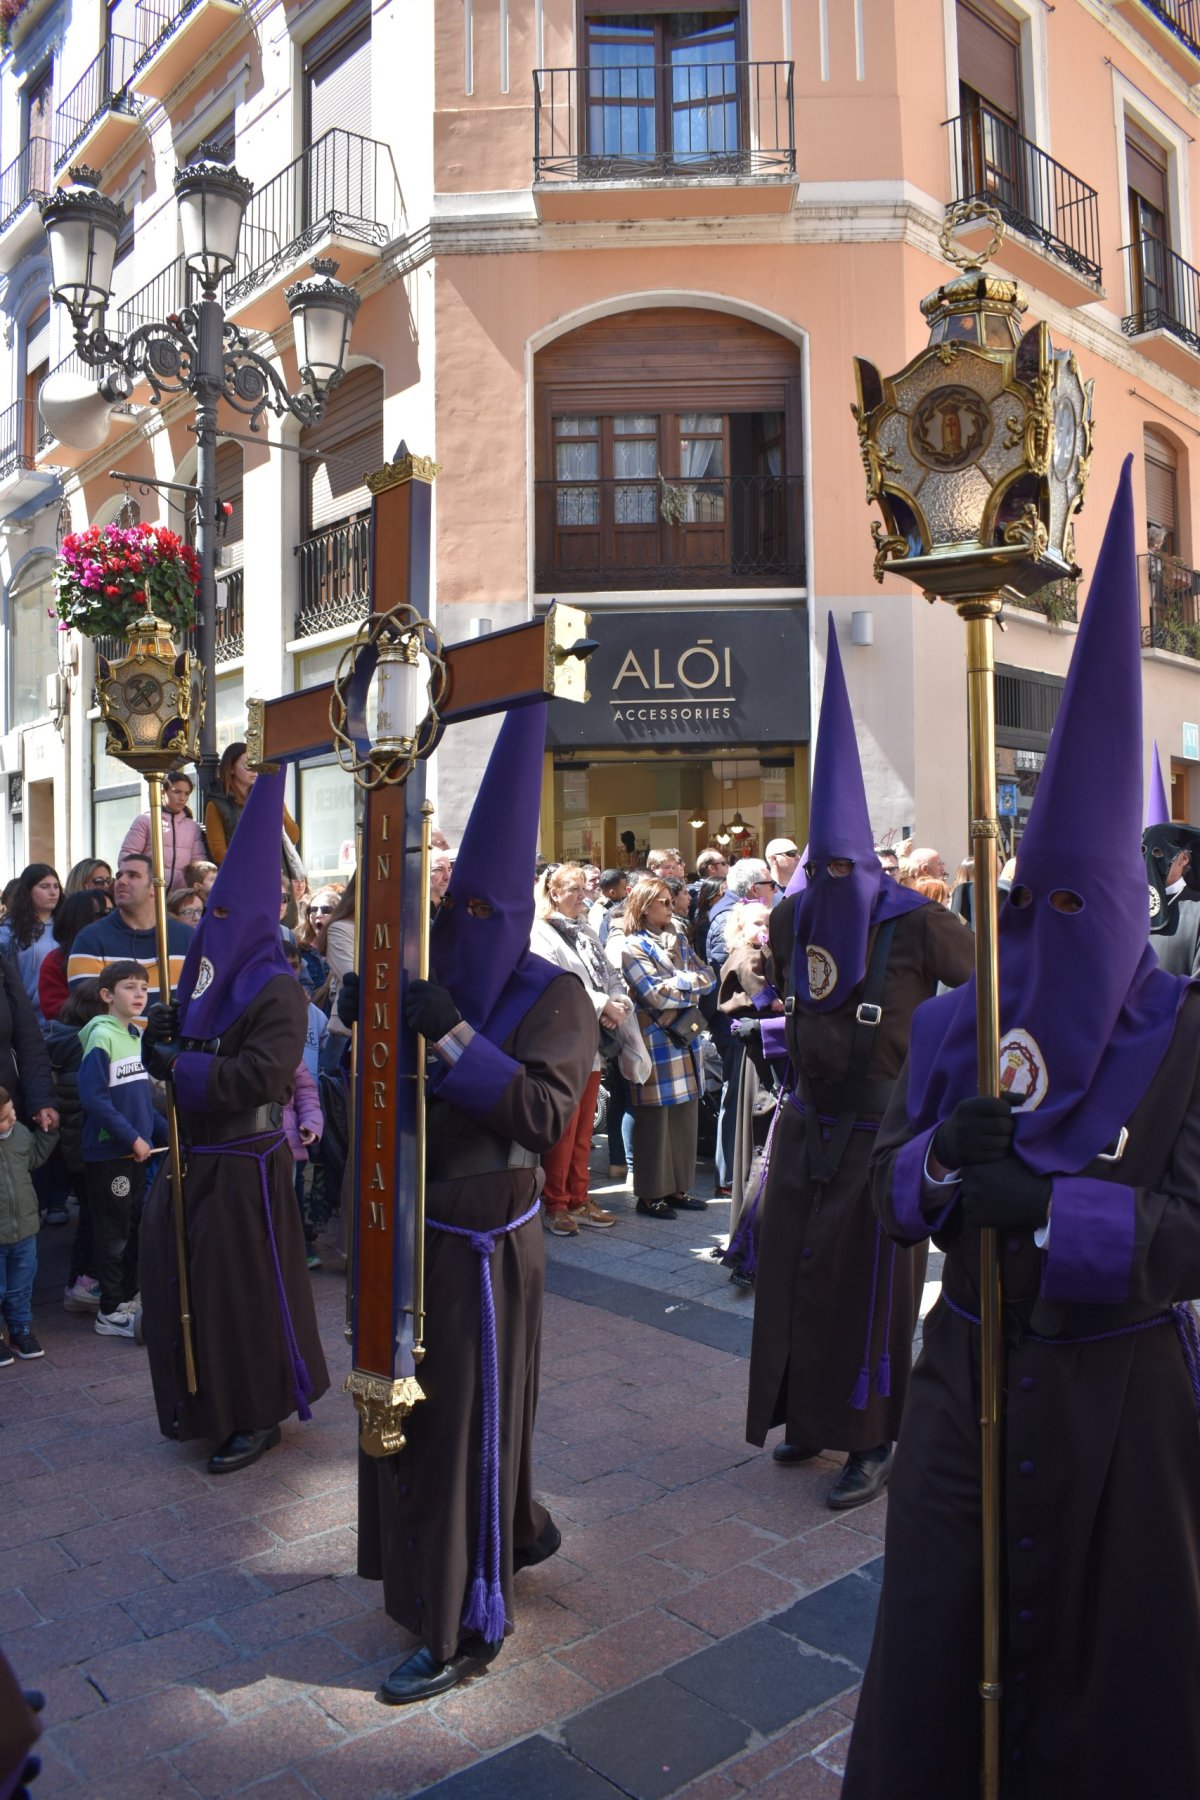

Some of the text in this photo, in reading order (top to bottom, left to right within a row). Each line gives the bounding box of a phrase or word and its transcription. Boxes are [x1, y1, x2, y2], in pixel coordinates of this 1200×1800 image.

[613, 707, 731, 721] ACCESSORIES
[368, 814, 392, 1231] IN MEMORIAM
